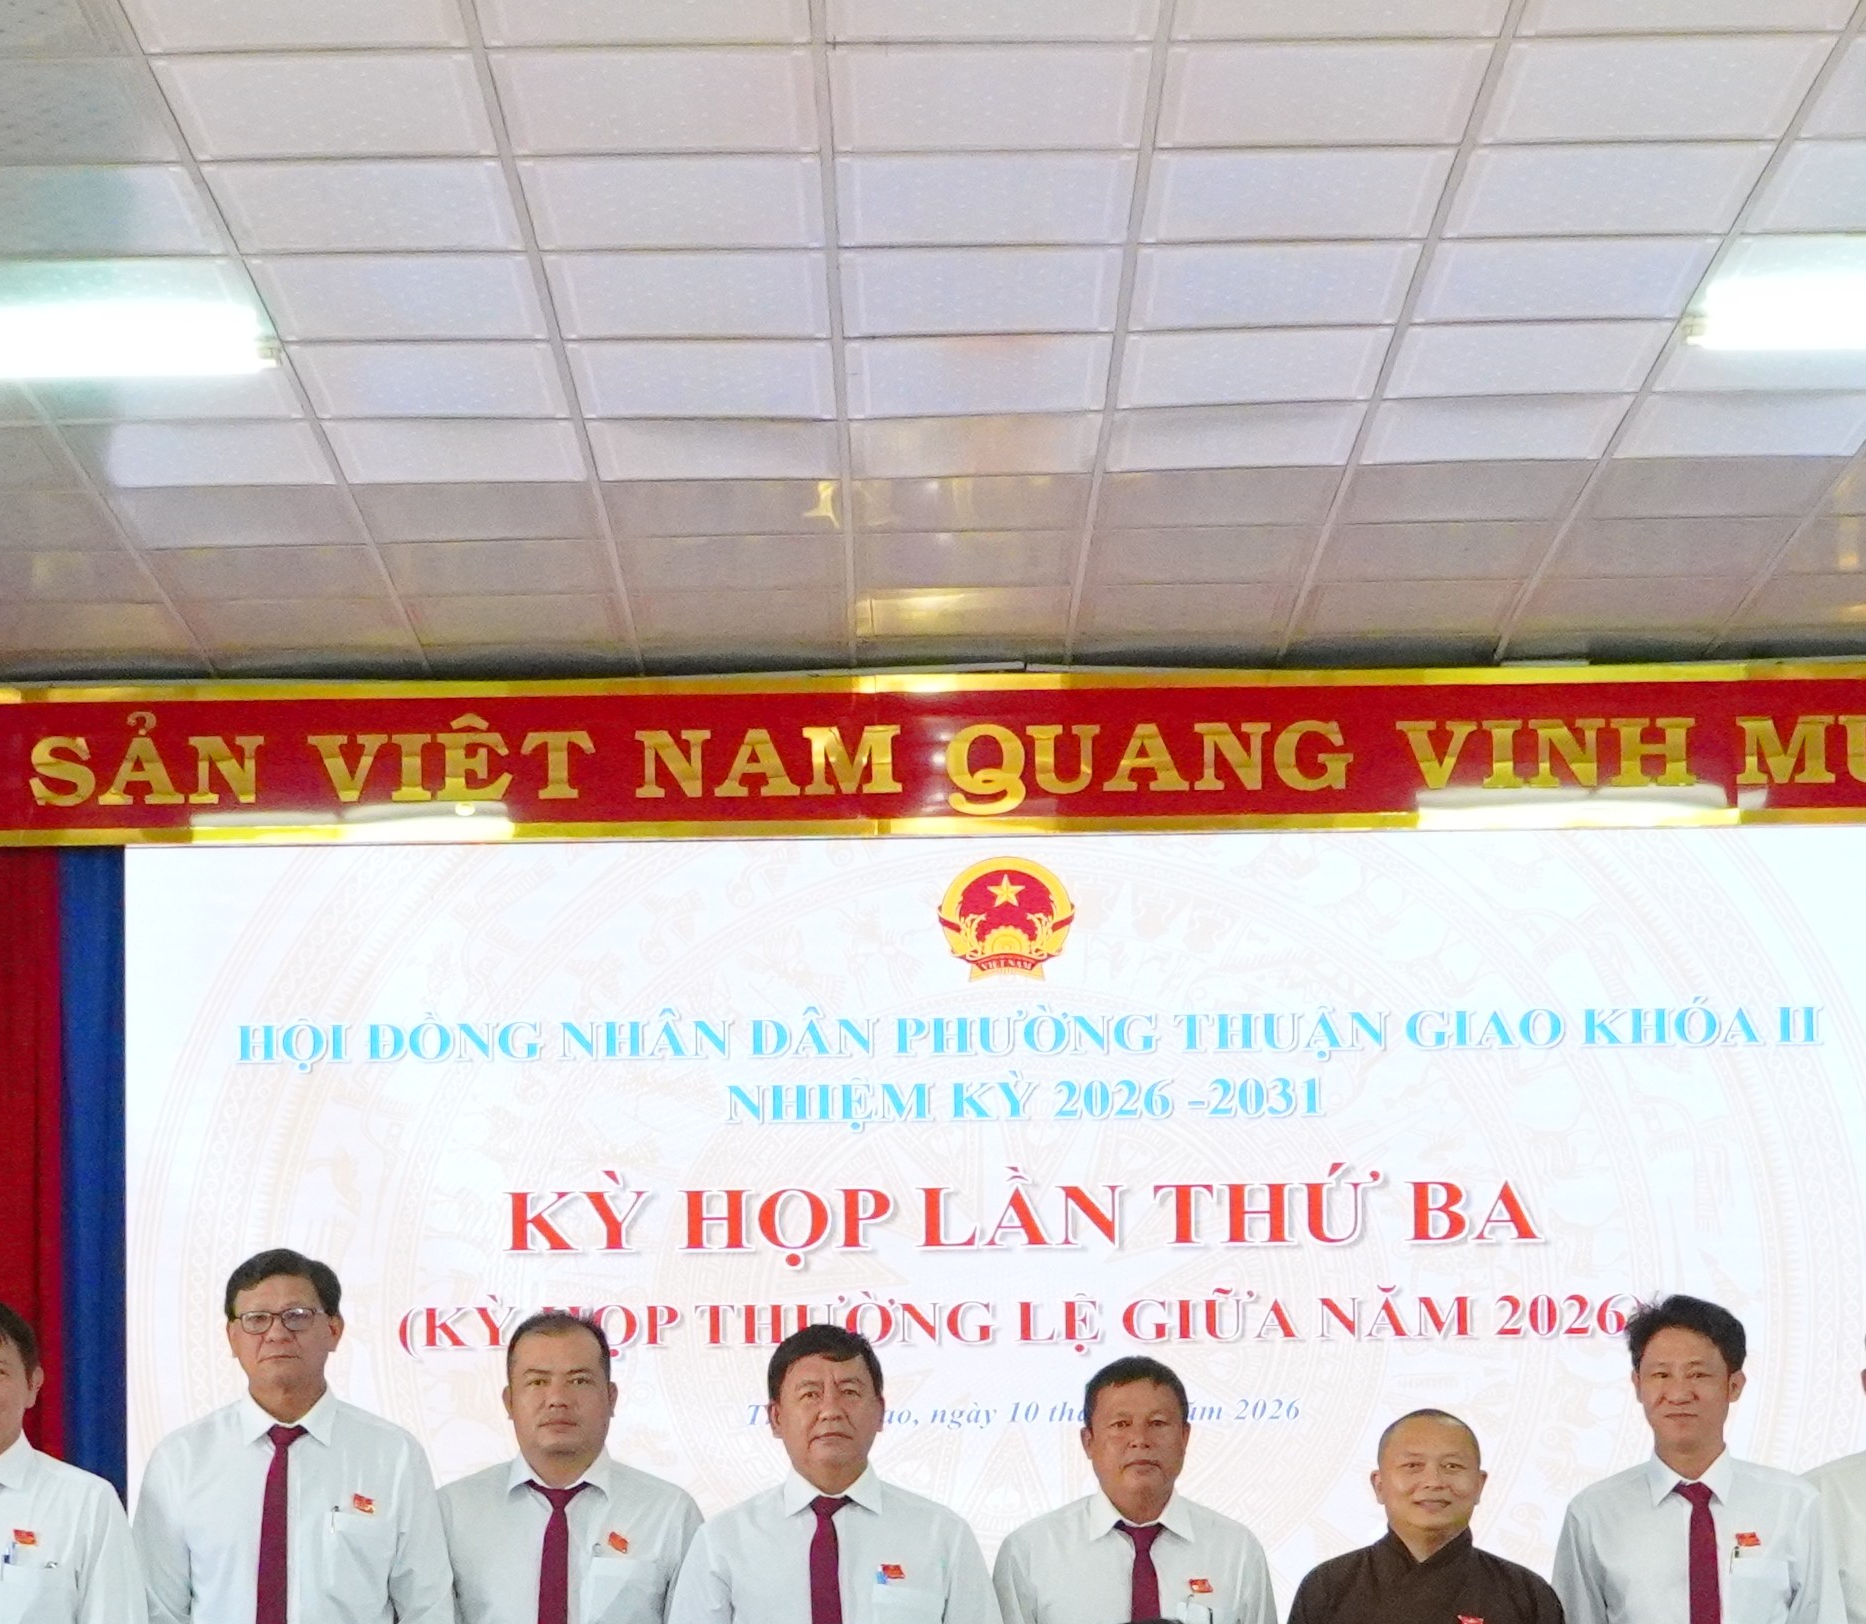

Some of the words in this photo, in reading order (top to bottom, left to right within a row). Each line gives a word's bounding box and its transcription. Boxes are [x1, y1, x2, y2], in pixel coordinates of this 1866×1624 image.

[29, 713, 264, 806] SẢN
[308, 712, 596, 815] VIỆT
[634, 724, 903, 799] NAM
[945, 720, 1354, 815] QUANG
[1396, 717, 1697, 790] VINH
[236, 1018, 347, 1072] HỘI
[367, 1012, 541, 1062] ĐỒNG
[559, 1007, 731, 1058] NHÂN
[750, 1006, 877, 1057] DÂN
[896, 1003, 1156, 1055] PHƯỜNG
[1174, 1006, 1388, 1060] THUẬN
[1405, 1007, 1566, 1048] GIAO
[1582, 996, 1764, 1046] KHÓA
[1777, 1005, 1823, 1044] II
[727, 1080, 932, 1131] NHIỆM
[950, 1070, 1029, 1120] KỲ
[1054, 1078, 1172, 1119] 2026
[1187, 1076, 1324, 1116] -2031
[507, 1170, 648, 1252] KỲ
[680, 1188, 892, 1268] HỌP
[917, 1166, 1122, 1248] LẦN
[1152, 1162, 1384, 1244] THỨ
[1411, 1180, 1541, 1242] BA
[537, 1304, 680, 1360] ỌP
[1018, 1292, 1101, 1353] LỆ
[1122, 1286, 1301, 1342] GIỮA
[1316, 1286, 1479, 1340] NĂM
[1495, 1293, 1646, 1336] 2026
[931, 1401, 997, 1430] ngày
[1008, 1401, 1040, 1423] 10
[1188, 1401, 1223, 1421] ăm
[1234, 1398, 1300, 1421] 2026
